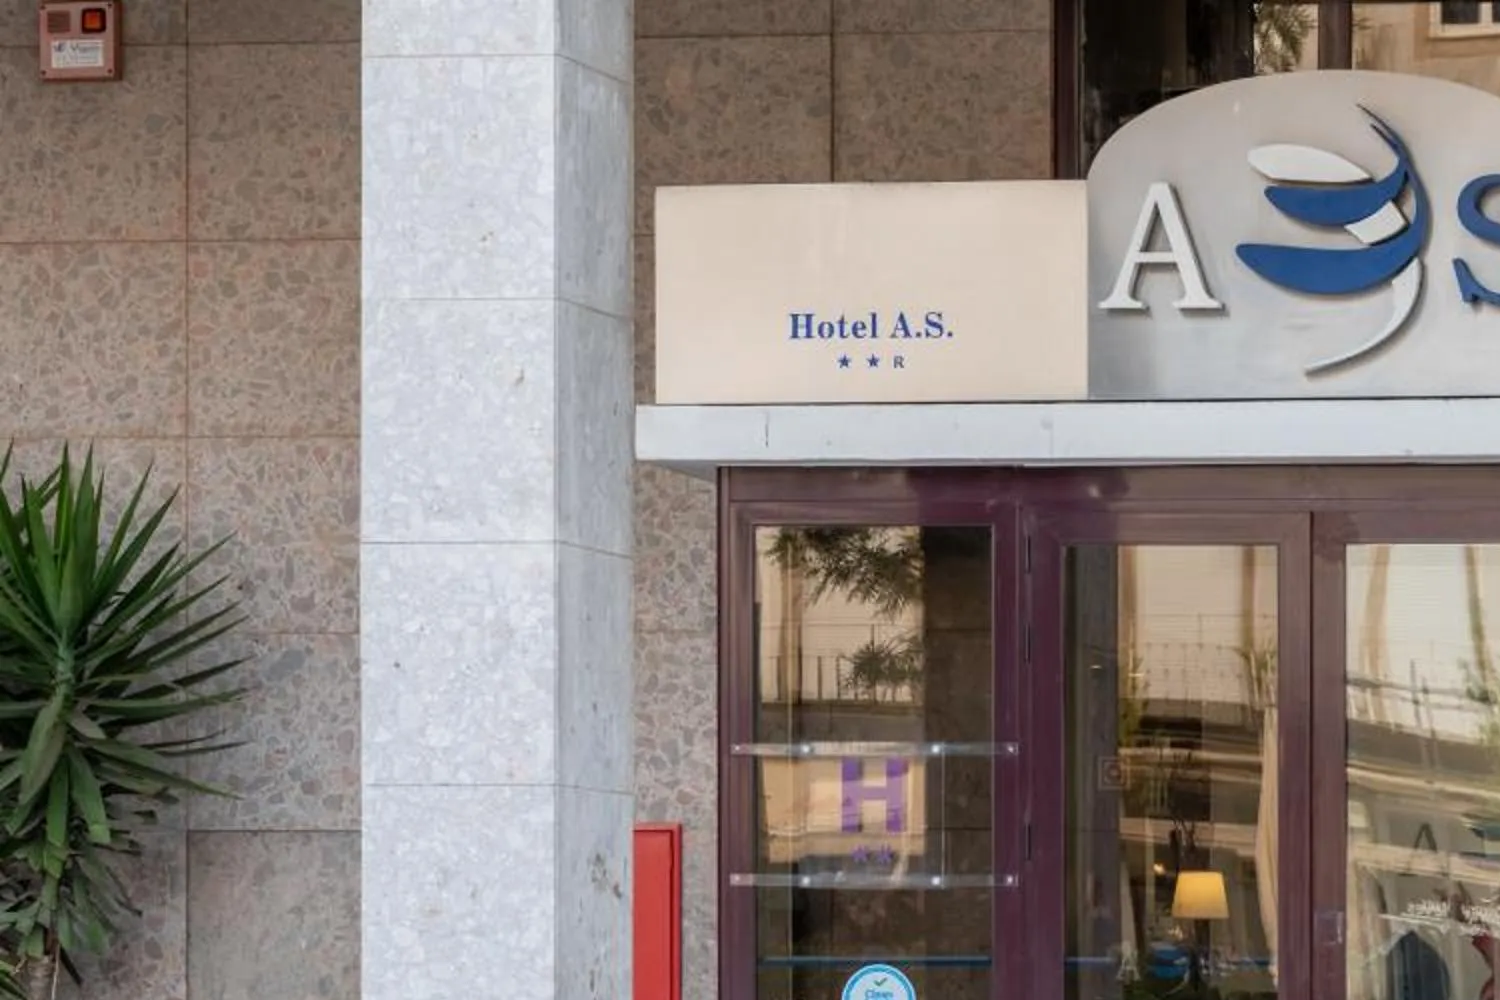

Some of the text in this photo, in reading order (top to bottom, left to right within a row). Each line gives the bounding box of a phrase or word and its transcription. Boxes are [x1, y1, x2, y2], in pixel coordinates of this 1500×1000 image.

[1098, 181, 1222, 310] A
[788, 311, 954, 339] Hotel A.S.
[893, 355, 905, 369] R
